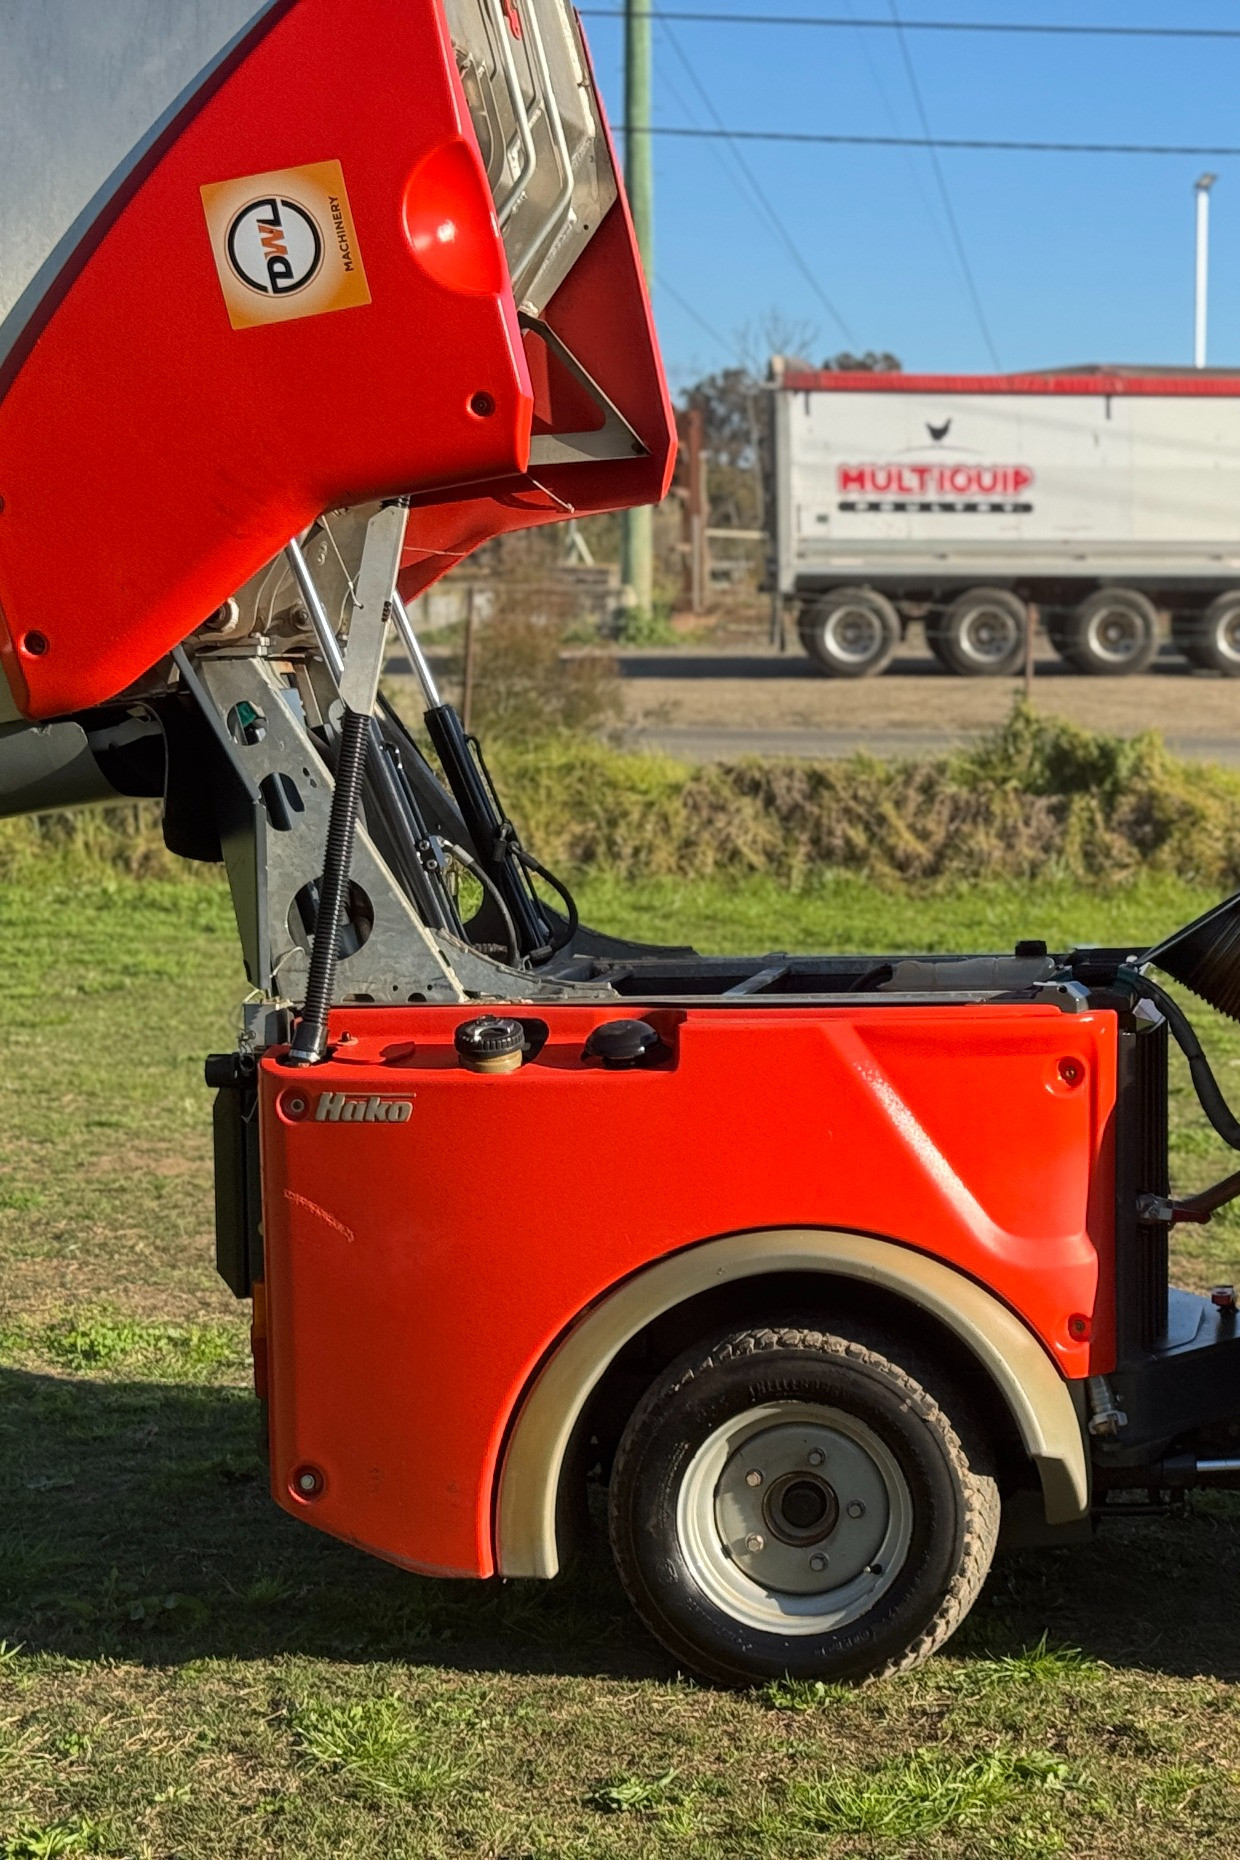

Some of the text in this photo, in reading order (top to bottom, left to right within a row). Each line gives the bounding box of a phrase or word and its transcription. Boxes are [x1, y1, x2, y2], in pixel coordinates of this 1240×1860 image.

[256, 198, 294, 294] DWL
[328, 196, 354, 272] MACHINERY
[315, 1091, 415, 1122] Hako
